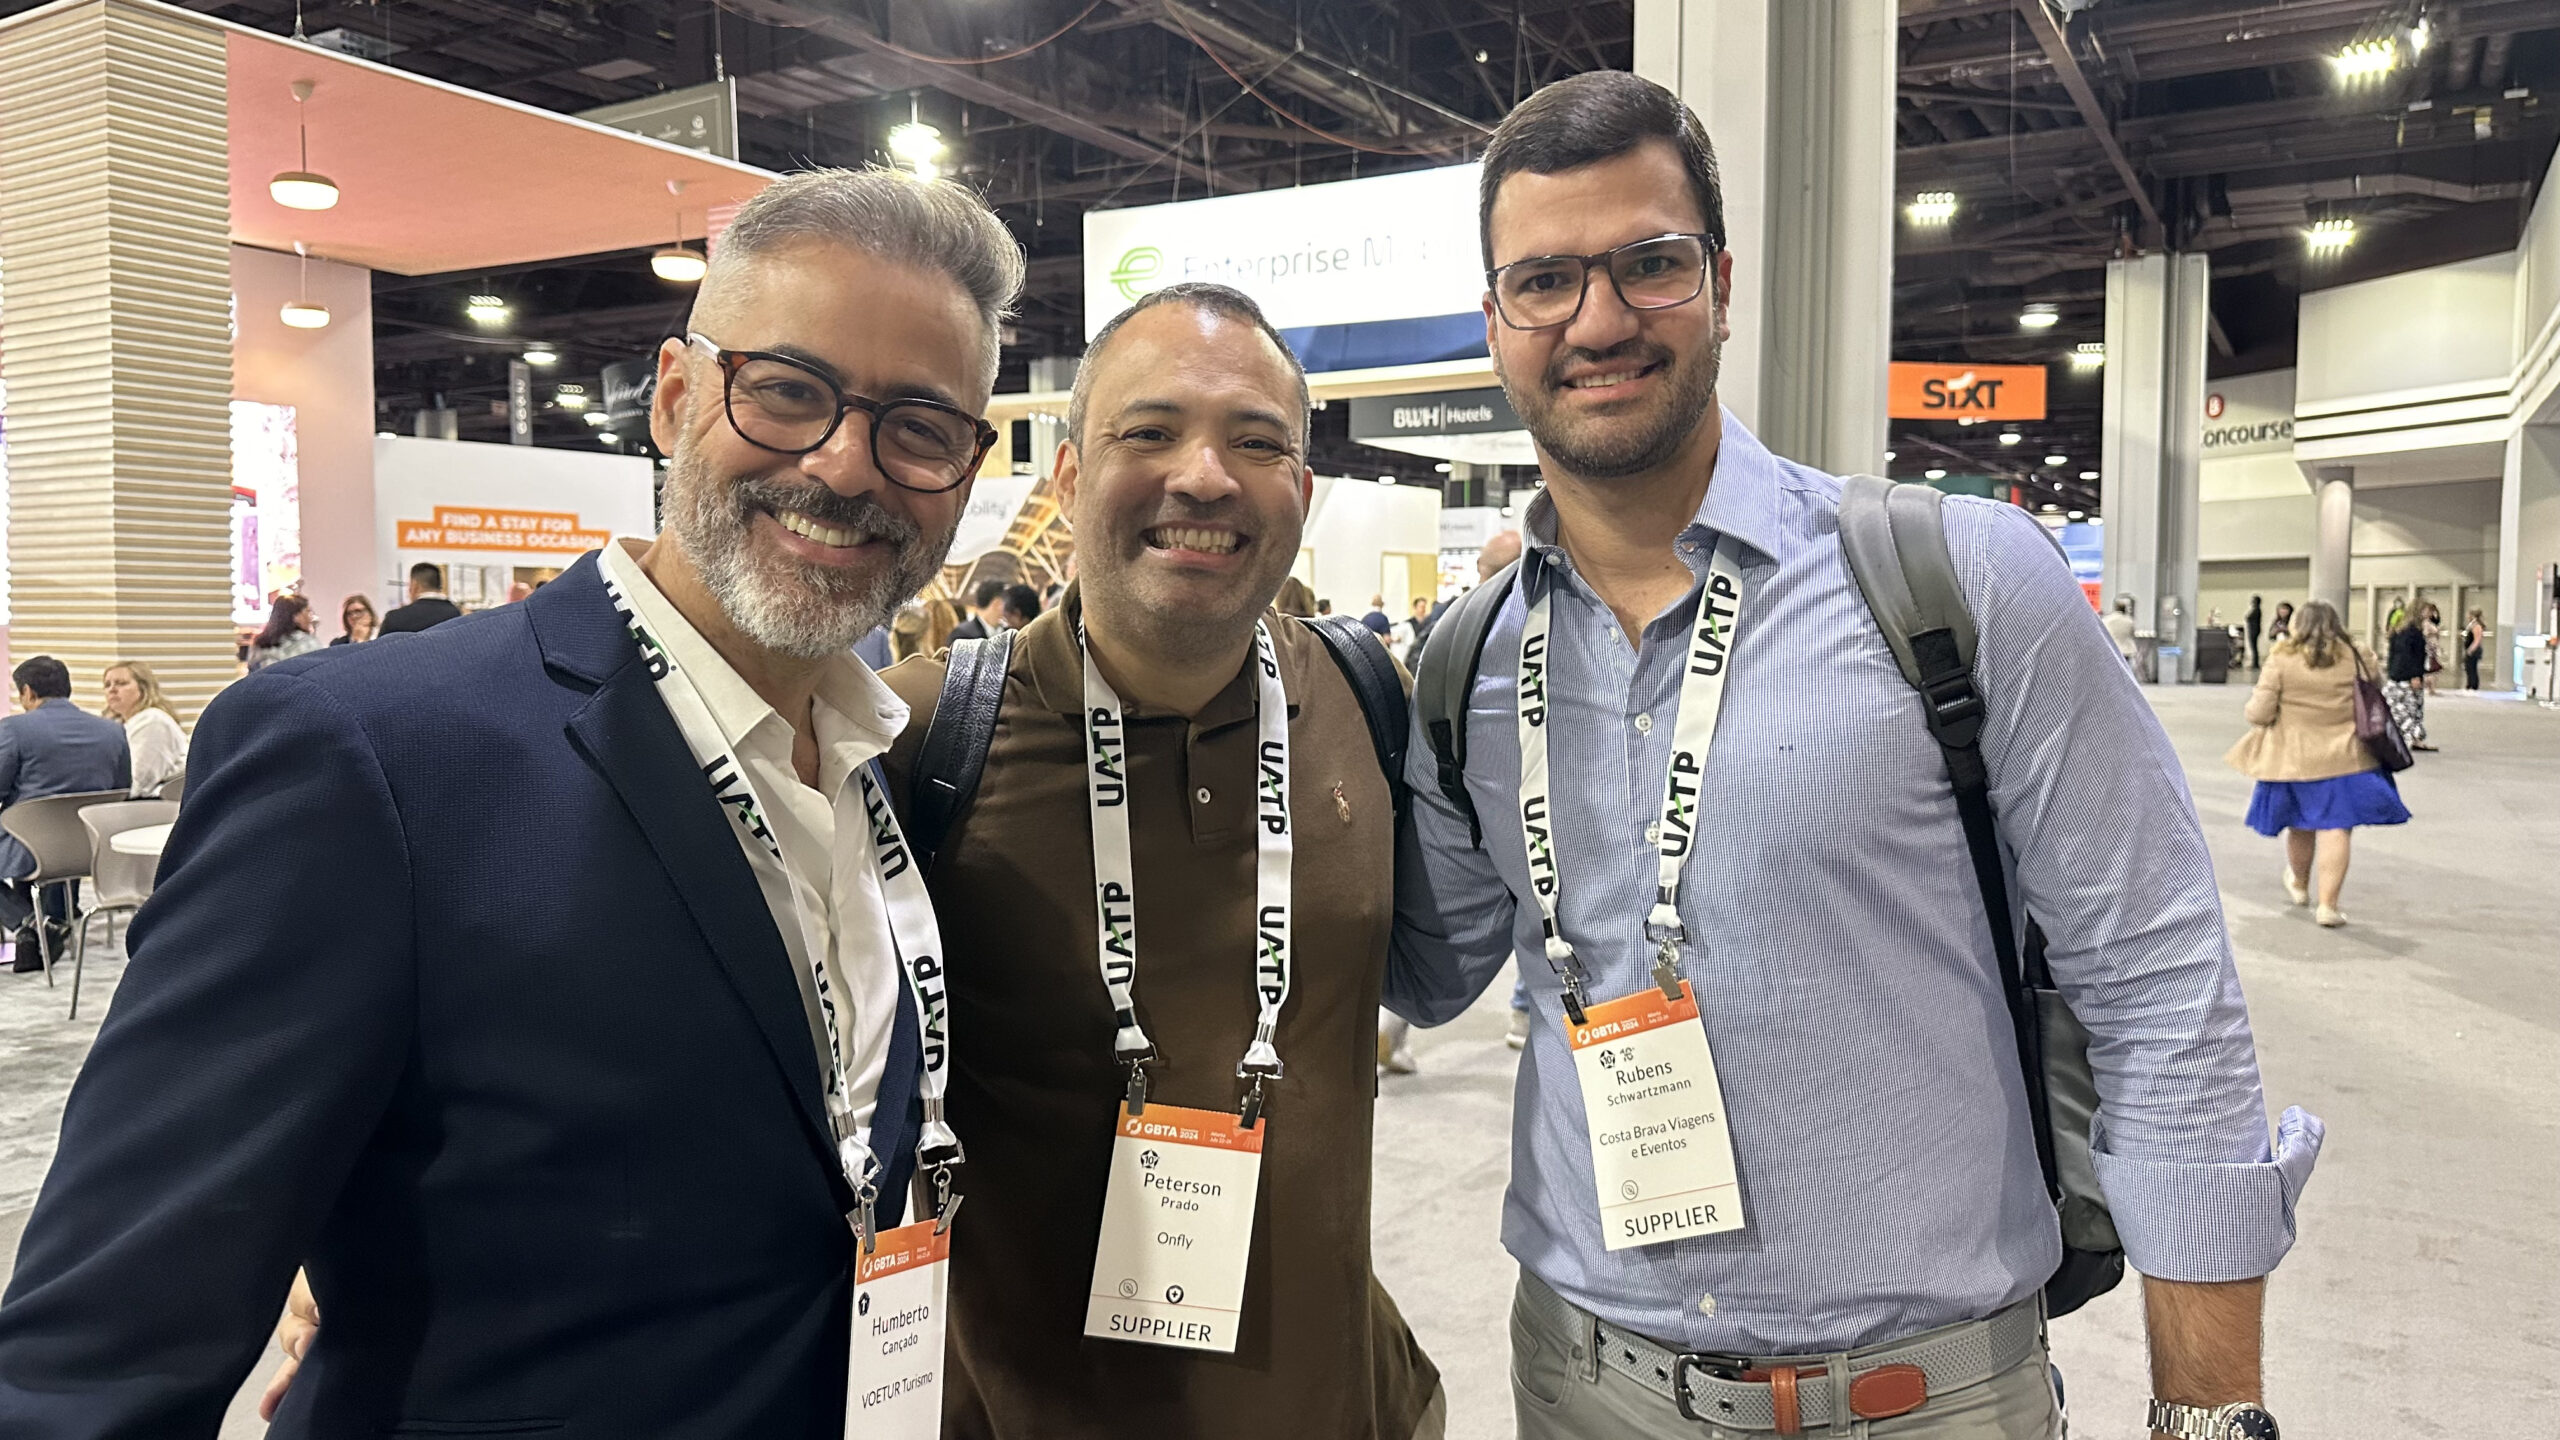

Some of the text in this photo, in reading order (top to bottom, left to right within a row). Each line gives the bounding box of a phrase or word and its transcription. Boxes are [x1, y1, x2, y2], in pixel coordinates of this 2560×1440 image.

[1393, 405, 1494, 428] BWH Hotels
[2201, 419, 2292, 448] oncourse
[441, 512, 573, 531] FIND A STAY FOR
[405, 528, 605, 549] ANY BUSINESS OCCASION
[1691, 574, 1738, 677] UATP
[1521, 633, 1545, 727] UATP
[1091, 706, 1124, 807] UATP
[1260, 741, 1285, 835] UATP
[1661, 751, 1700, 857] UATP
[1523, 795, 1554, 896] UATP
[1103, 881, 1134, 987] UATP
[1260, 905, 1285, 1005] UATP
[913, 954, 945, 1073] UATP
[1591, 1022, 1621, 1040] GBTA
[1616, 1062, 1673, 1086] Rubens
[1607, 1078, 1692, 1107] Schwartzmann
[1144, 1123, 1178, 1138] GBTA
[1599, 1112, 1716, 1146] Costa Brava Viagens
[1631, 1137, 1688, 1158] e Eventos
[1144, 1172, 1222, 1197] Peterson
[1161, 1196, 1199, 1212] Prado
[1624, 1204, 1719, 1238] SUPPLIER
[1157, 1231, 1194, 1250] Onfly
[874, 1253, 896, 1272] GBTA
[872, 1304, 930, 1337] Humberto
[1109, 1314, 1212, 1343] SUPPLIER
[882, 1332, 919, 1356] Cançado
[861, 1370, 934, 1409] VOETUR Turismo
